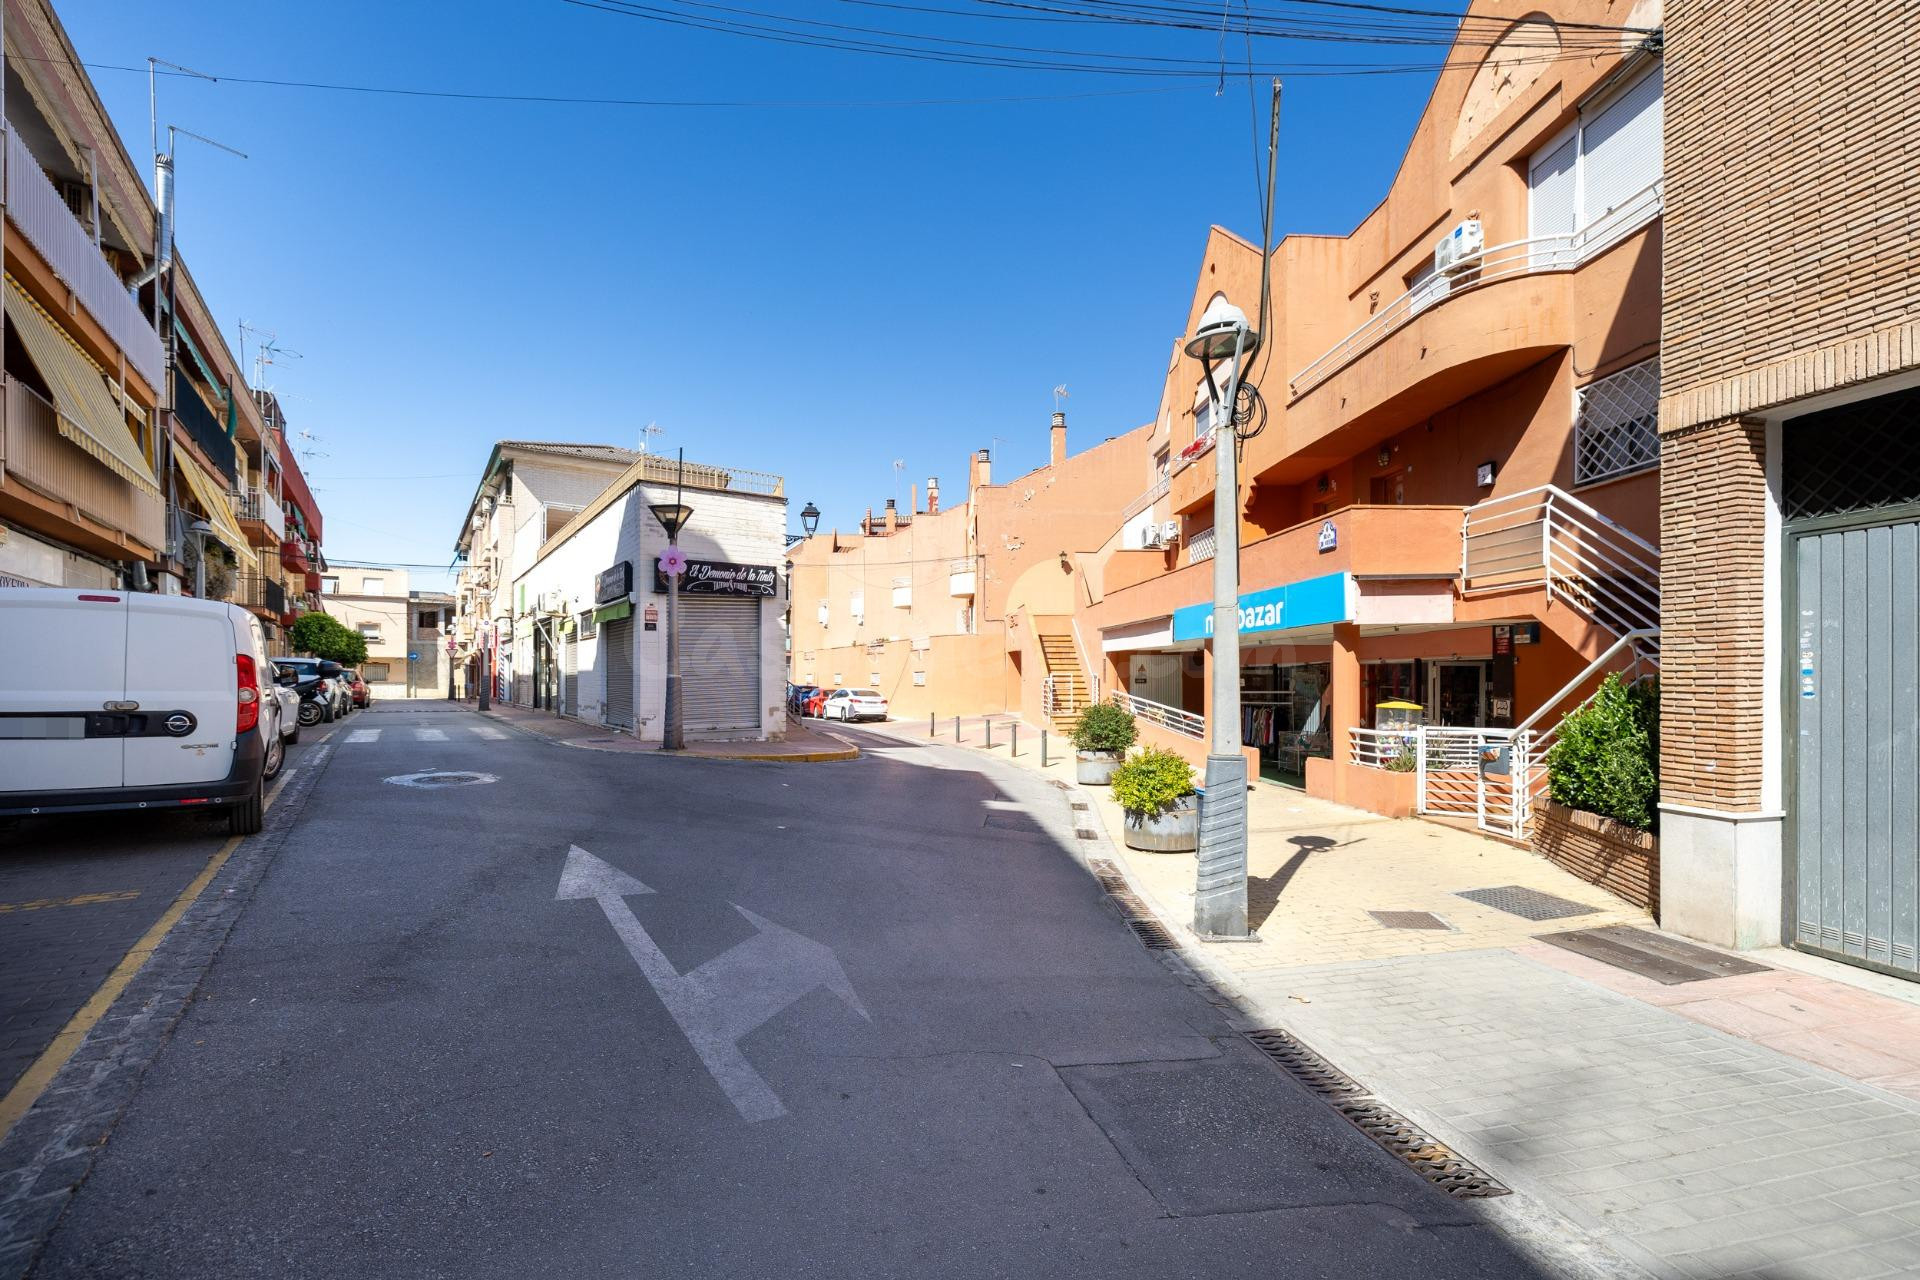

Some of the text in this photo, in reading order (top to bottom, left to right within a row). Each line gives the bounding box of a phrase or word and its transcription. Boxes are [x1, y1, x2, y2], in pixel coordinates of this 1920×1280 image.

[689, 564, 775, 584] El Demonio de la Tinta
